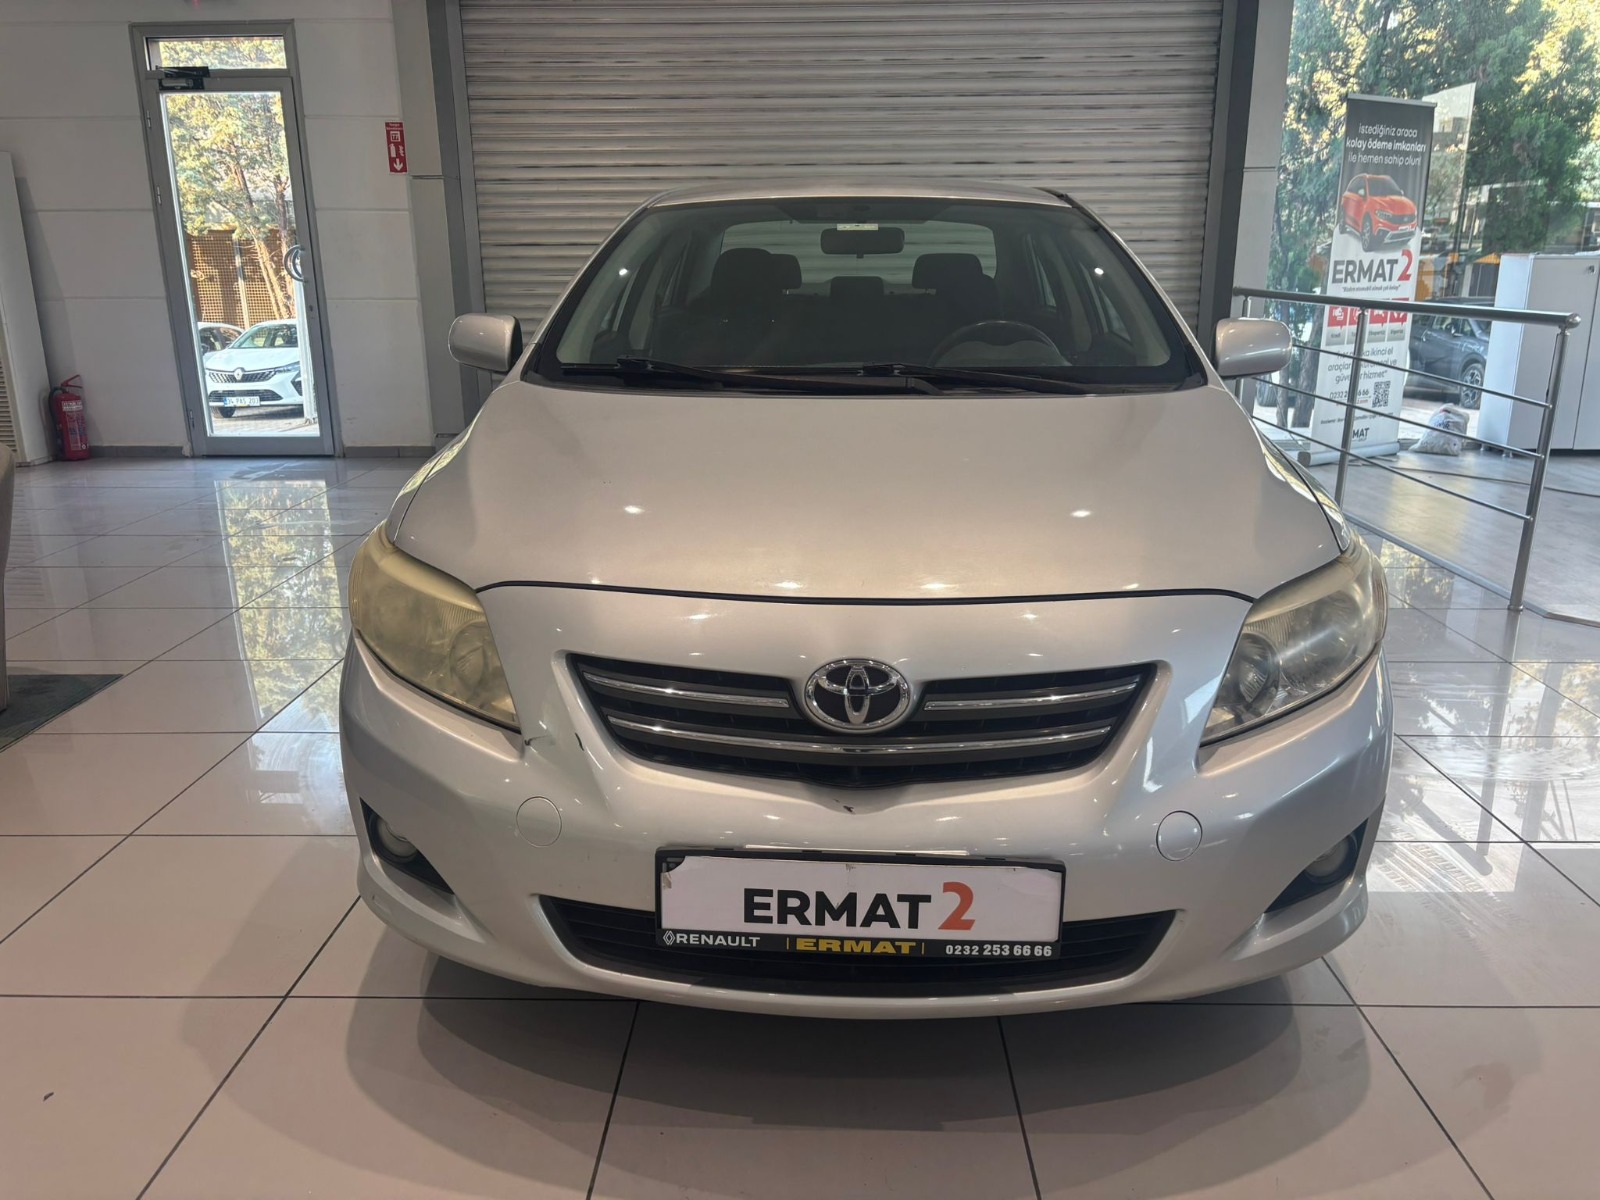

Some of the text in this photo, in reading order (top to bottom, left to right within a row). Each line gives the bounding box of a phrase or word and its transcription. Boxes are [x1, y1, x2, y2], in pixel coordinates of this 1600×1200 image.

[1396, 128, 1418, 138] araca
[1346, 137, 1367, 151] kolay
[1367, 138, 1393, 150] ödeme
[1358, 153, 1383, 164] hemen
[1384, 154, 1404, 167] sahip
[1331, 249, 1413, 284] ERMAT 2
[1327, 362, 1352, 372] araçlar
[1352, 427, 1370, 439] MAT
[743, 881, 976, 931] ERMAT 2
[676, 933, 1052, 957] RENAULT ERMAT 0232 253 66 66
